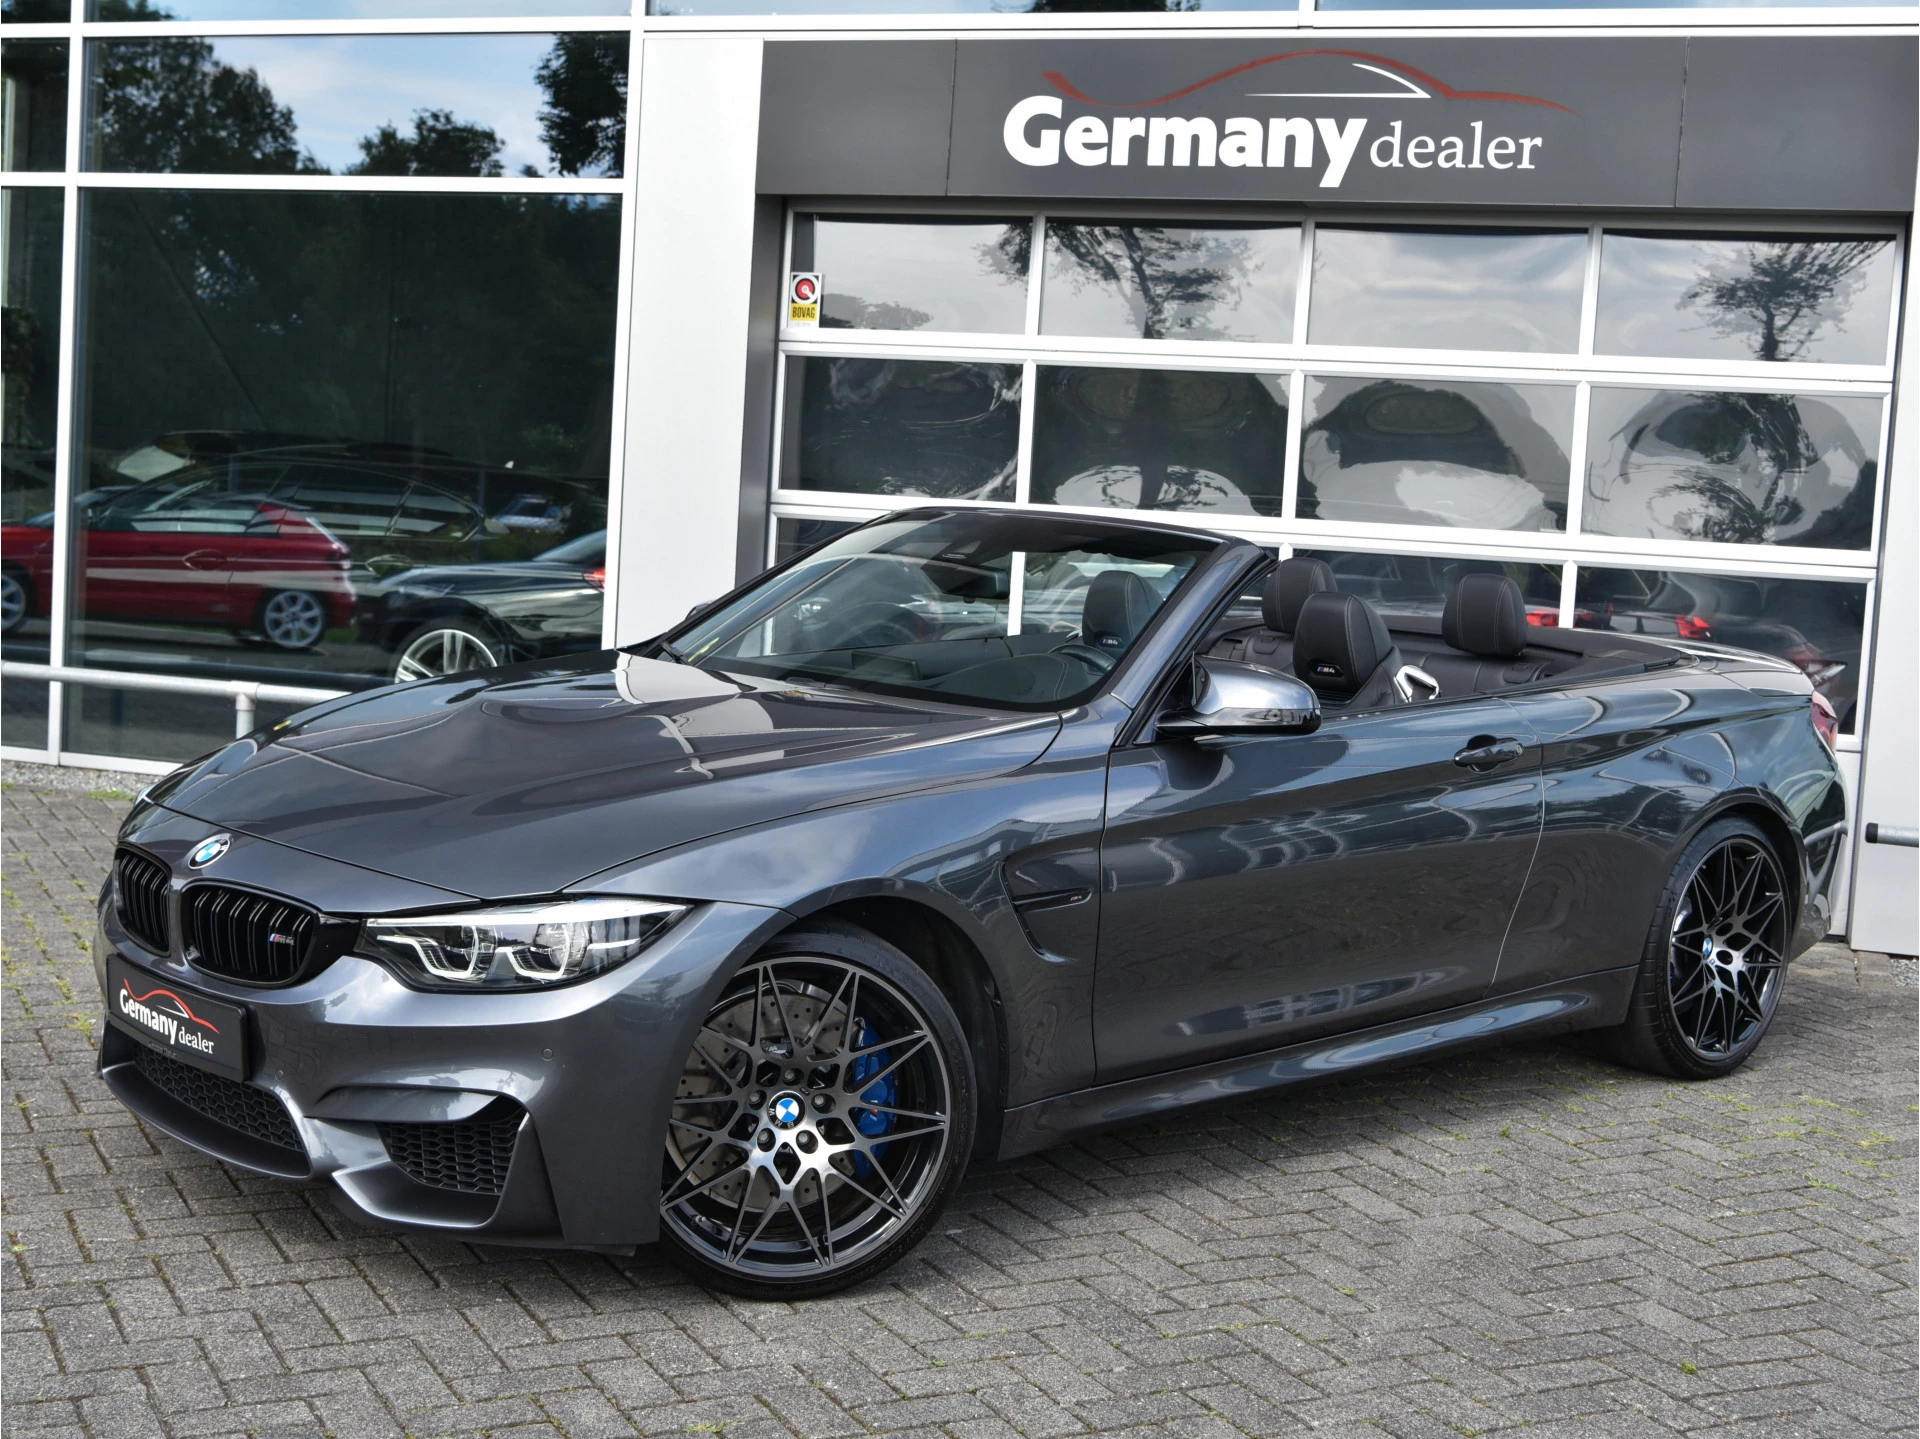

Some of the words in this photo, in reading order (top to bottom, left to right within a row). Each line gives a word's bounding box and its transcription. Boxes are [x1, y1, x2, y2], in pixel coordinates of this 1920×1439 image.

[1003, 95, 1367, 187] Germany
[1369, 121, 1542, 169] dealer
[792, 306, 816, 319] BOVAG
[120, 988, 178, 1045] Germany
[178, 1026, 214, 1054] dealer
